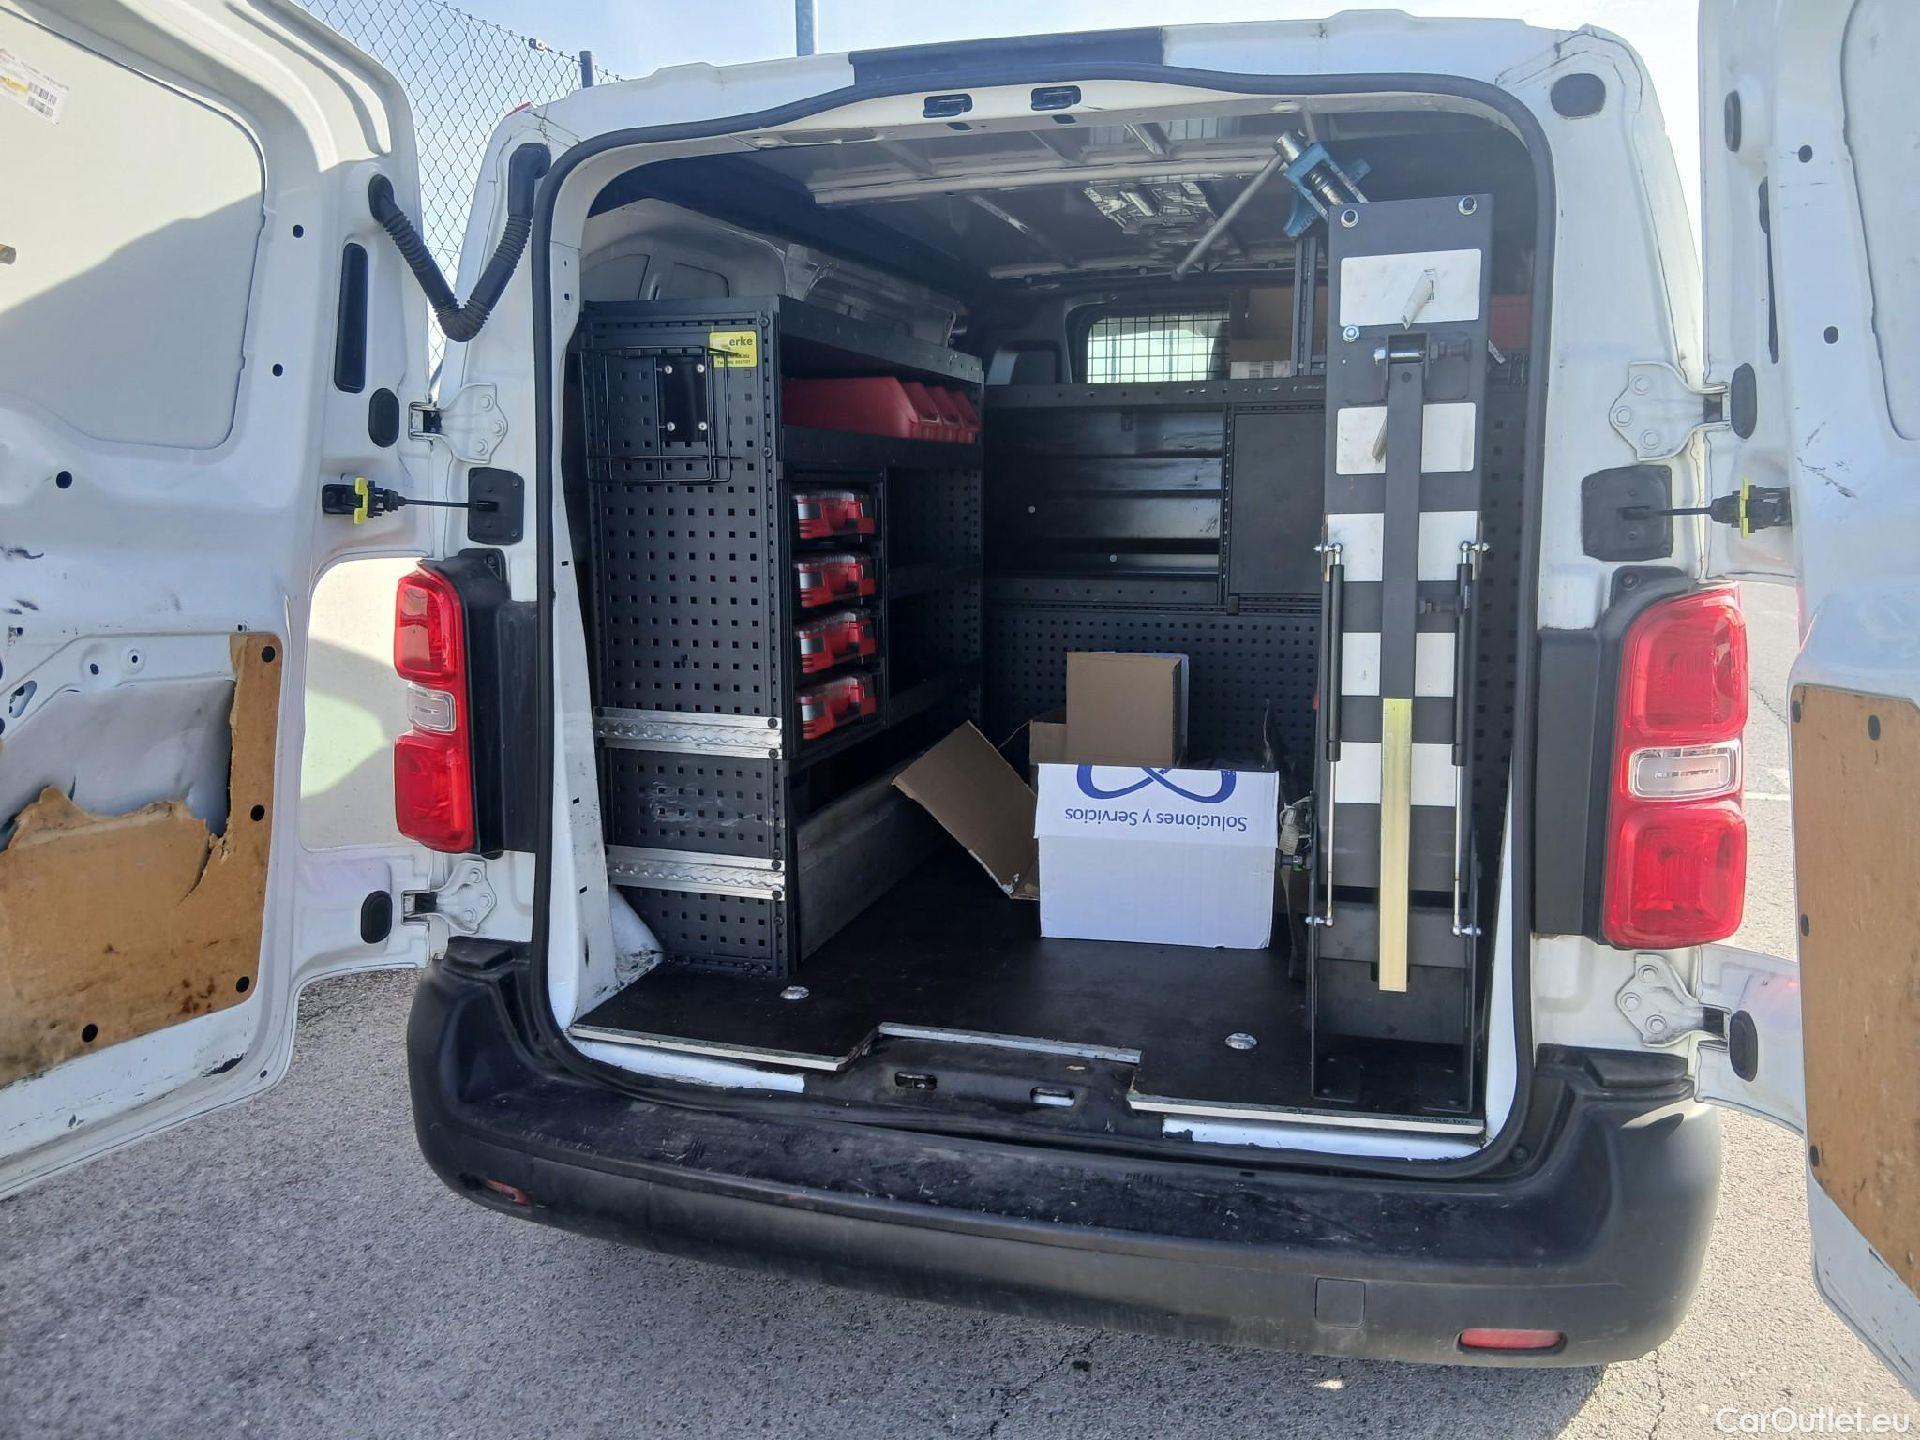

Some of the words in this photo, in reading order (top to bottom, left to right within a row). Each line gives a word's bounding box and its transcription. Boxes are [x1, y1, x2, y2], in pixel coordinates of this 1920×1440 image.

[1065, 807, 1138, 826] Servicios
[1142, 808, 1152, 824] y
[1156, 811, 1248, 832] Soluciones
